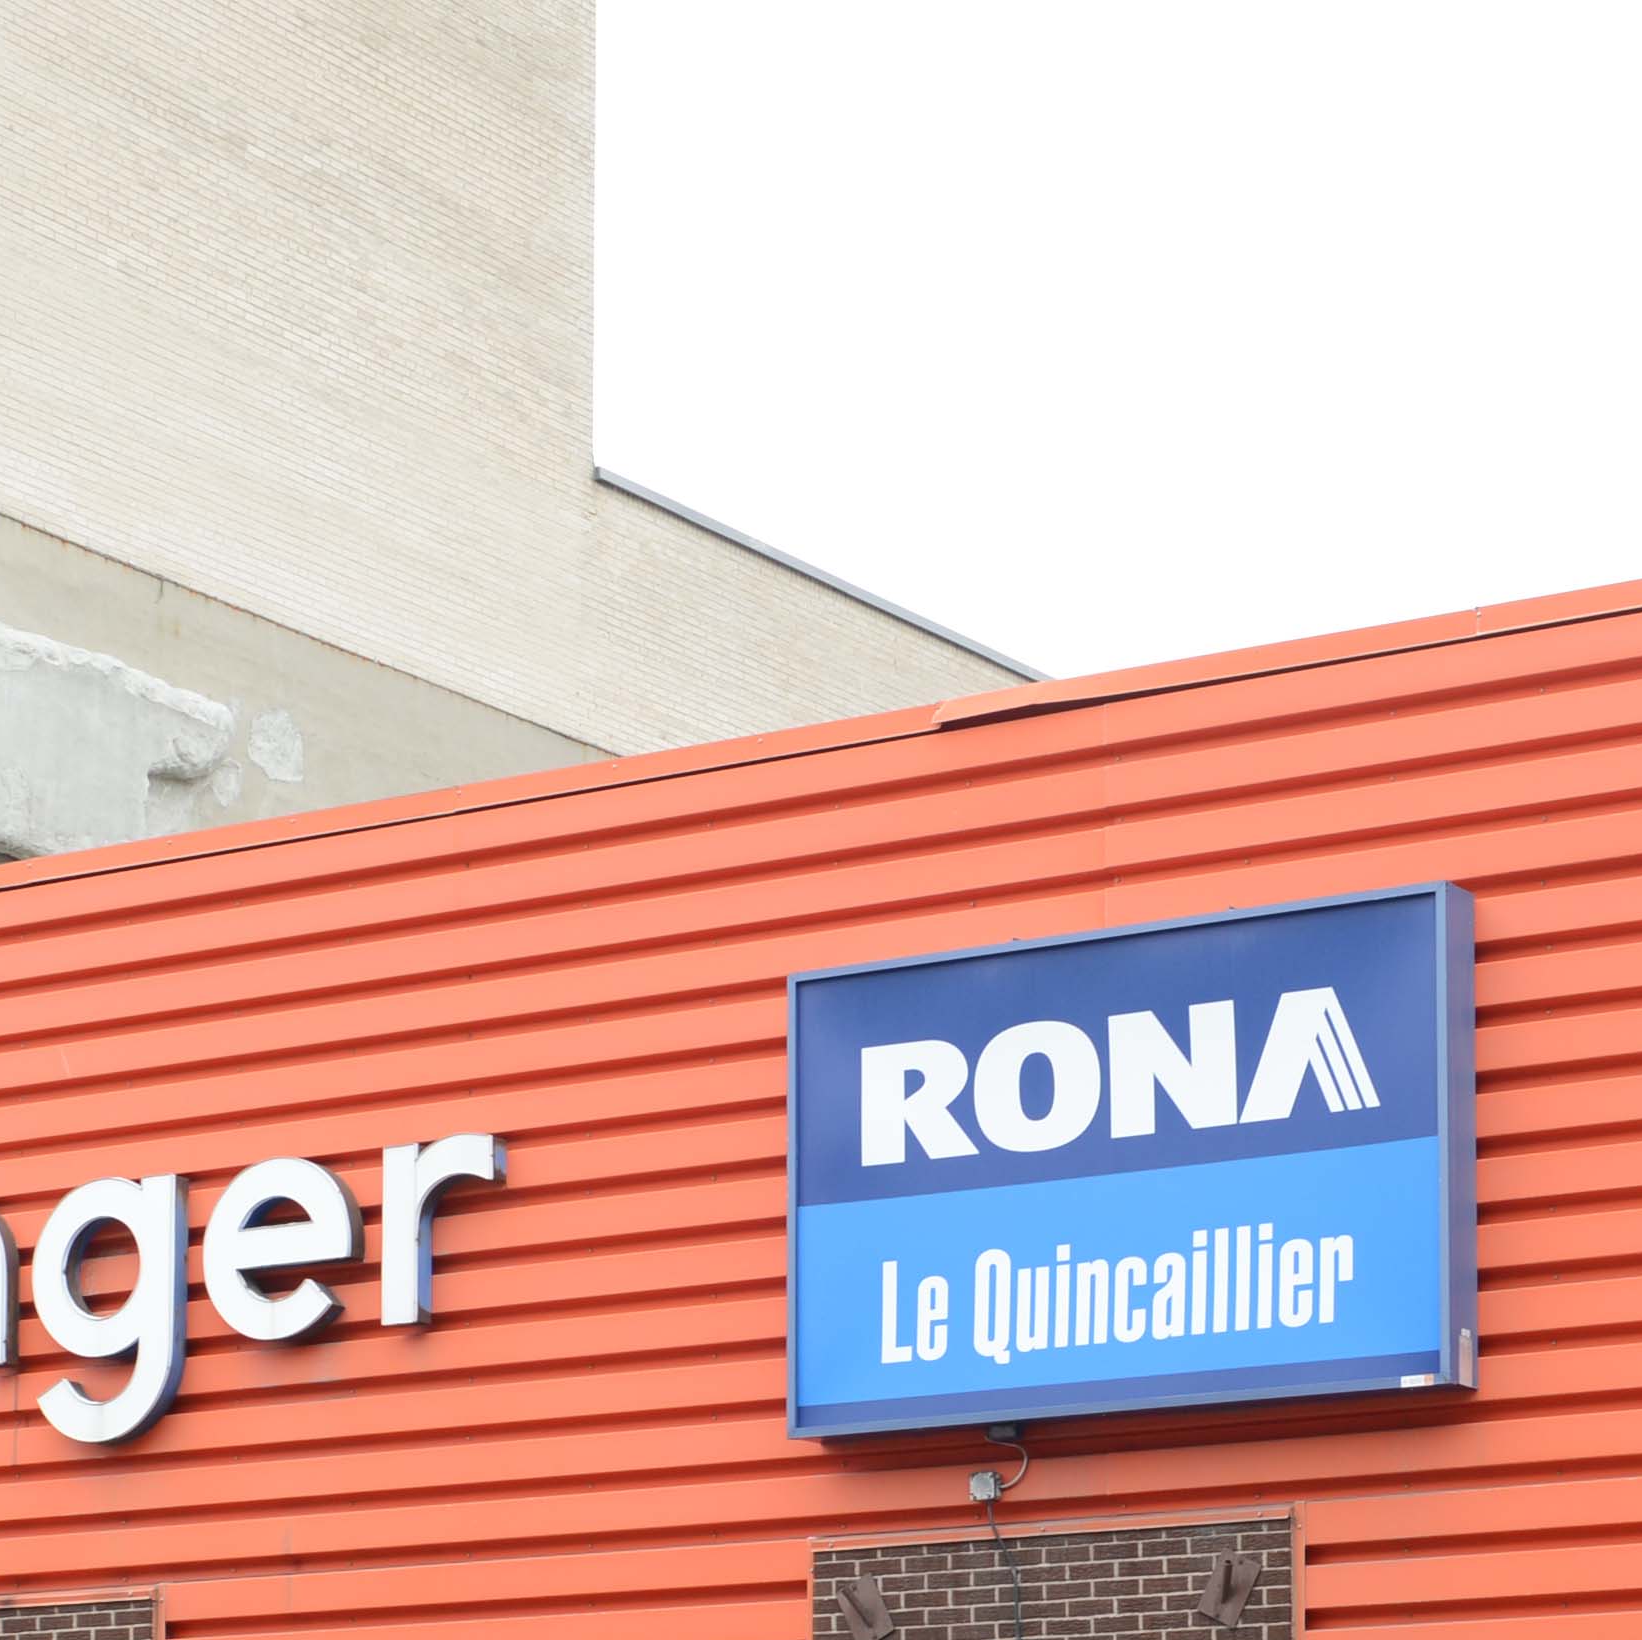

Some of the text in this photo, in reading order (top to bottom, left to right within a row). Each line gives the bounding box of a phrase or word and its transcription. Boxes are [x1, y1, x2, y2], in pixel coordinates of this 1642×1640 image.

[861, 986, 1381, 1167] RONA
[881, 1223, 1354, 1365] Le Quincaillier
